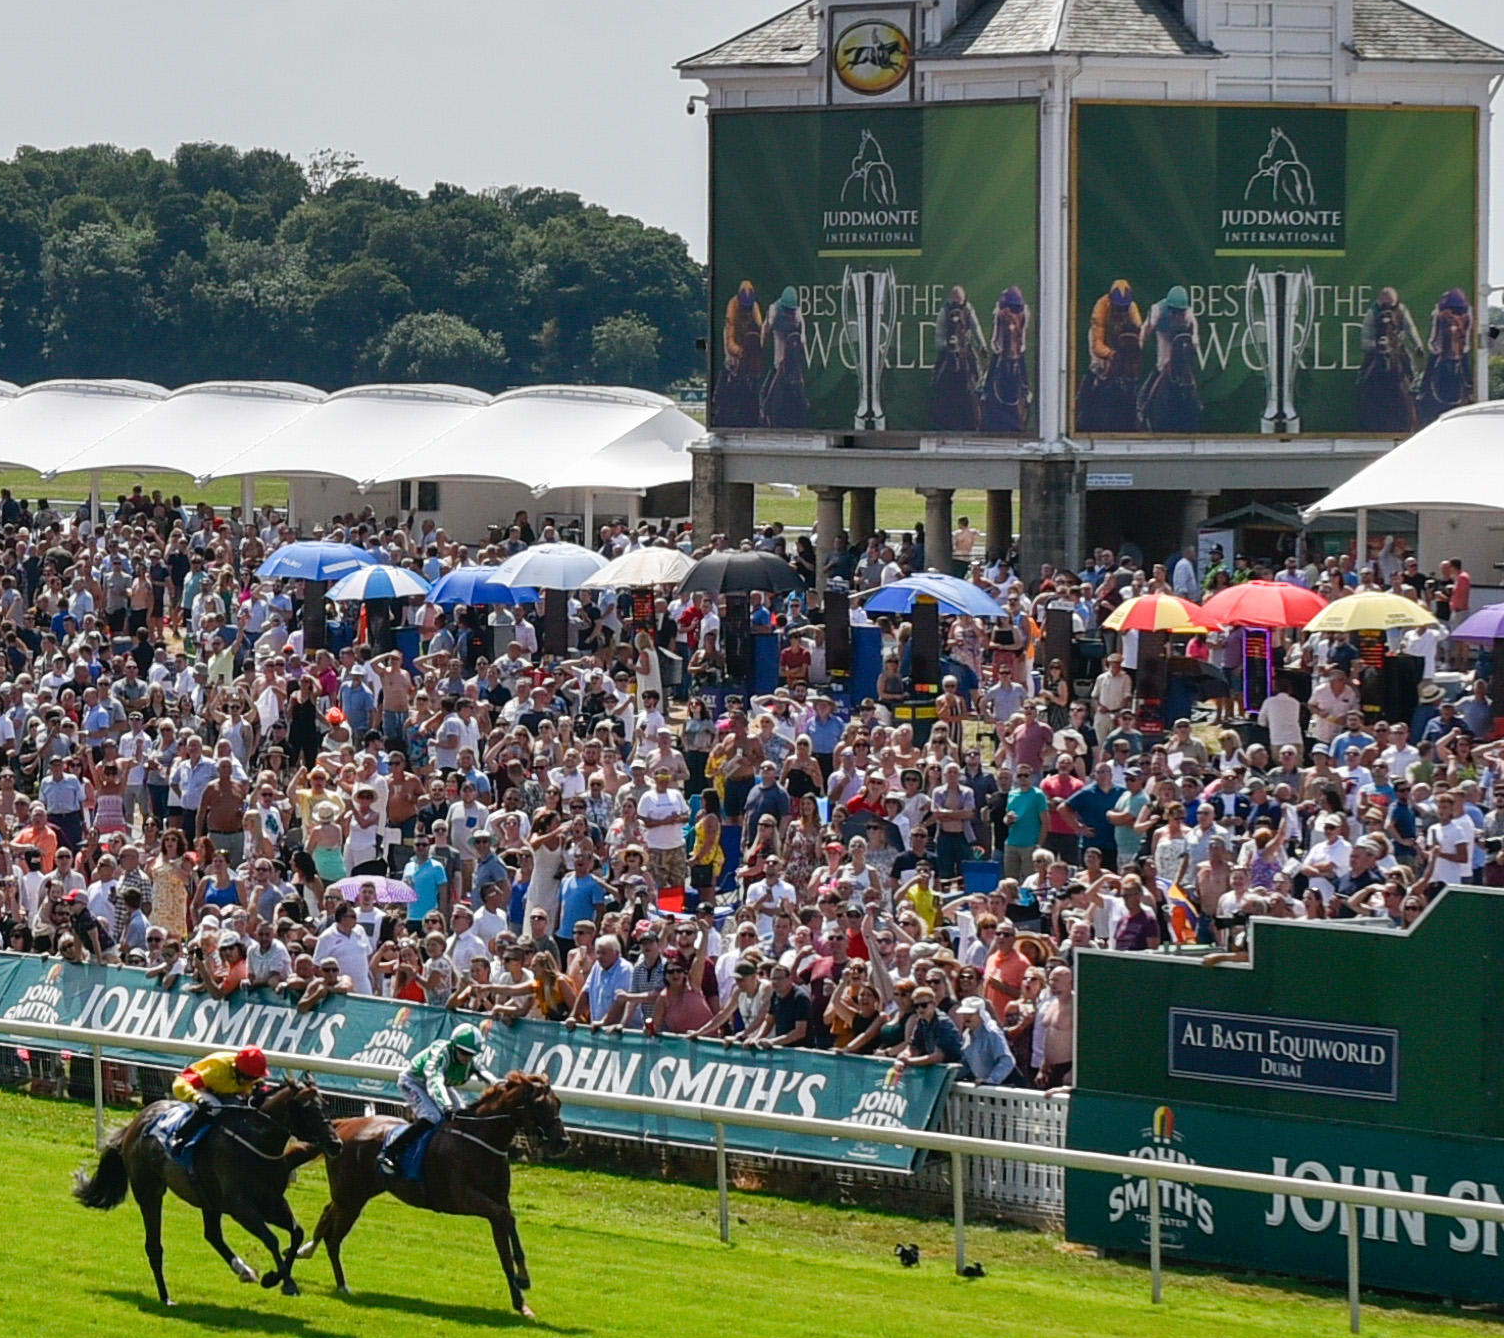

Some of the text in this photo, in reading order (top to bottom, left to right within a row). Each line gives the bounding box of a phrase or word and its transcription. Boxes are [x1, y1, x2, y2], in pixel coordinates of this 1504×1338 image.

[823, 211, 919, 229] JUDDMONTE
[1220, 210, 1342, 229] JUDDMONTE
[826, 232, 915, 243] INTERNATIONAL
[1225, 232, 1337, 243] INTERNATIONAL
[799, 285, 944, 317] BEST THE
[1190, 285, 1372, 317] BEST THE
[19, 982, 61, 1004] JOHN
[72, 983, 346, 1058] JOHN SMITH'S
[364, 1029, 413, 1052] JOHN
[1211, 1023, 1263, 1052] BASTI
[1268, 1029, 1386, 1066] EQUIWORLD
[523, 1041, 826, 1119] JOHN SMITH'S
[1260, 1057, 1302, 1078] DUBAI
[851, 1090, 908, 1118] JOHN
[1109, 1177, 1214, 1235] SMTH'S
[1265, 1156, 1429, 1247] JOHN
[1135, 1212, 1189, 1229] TADASTER
